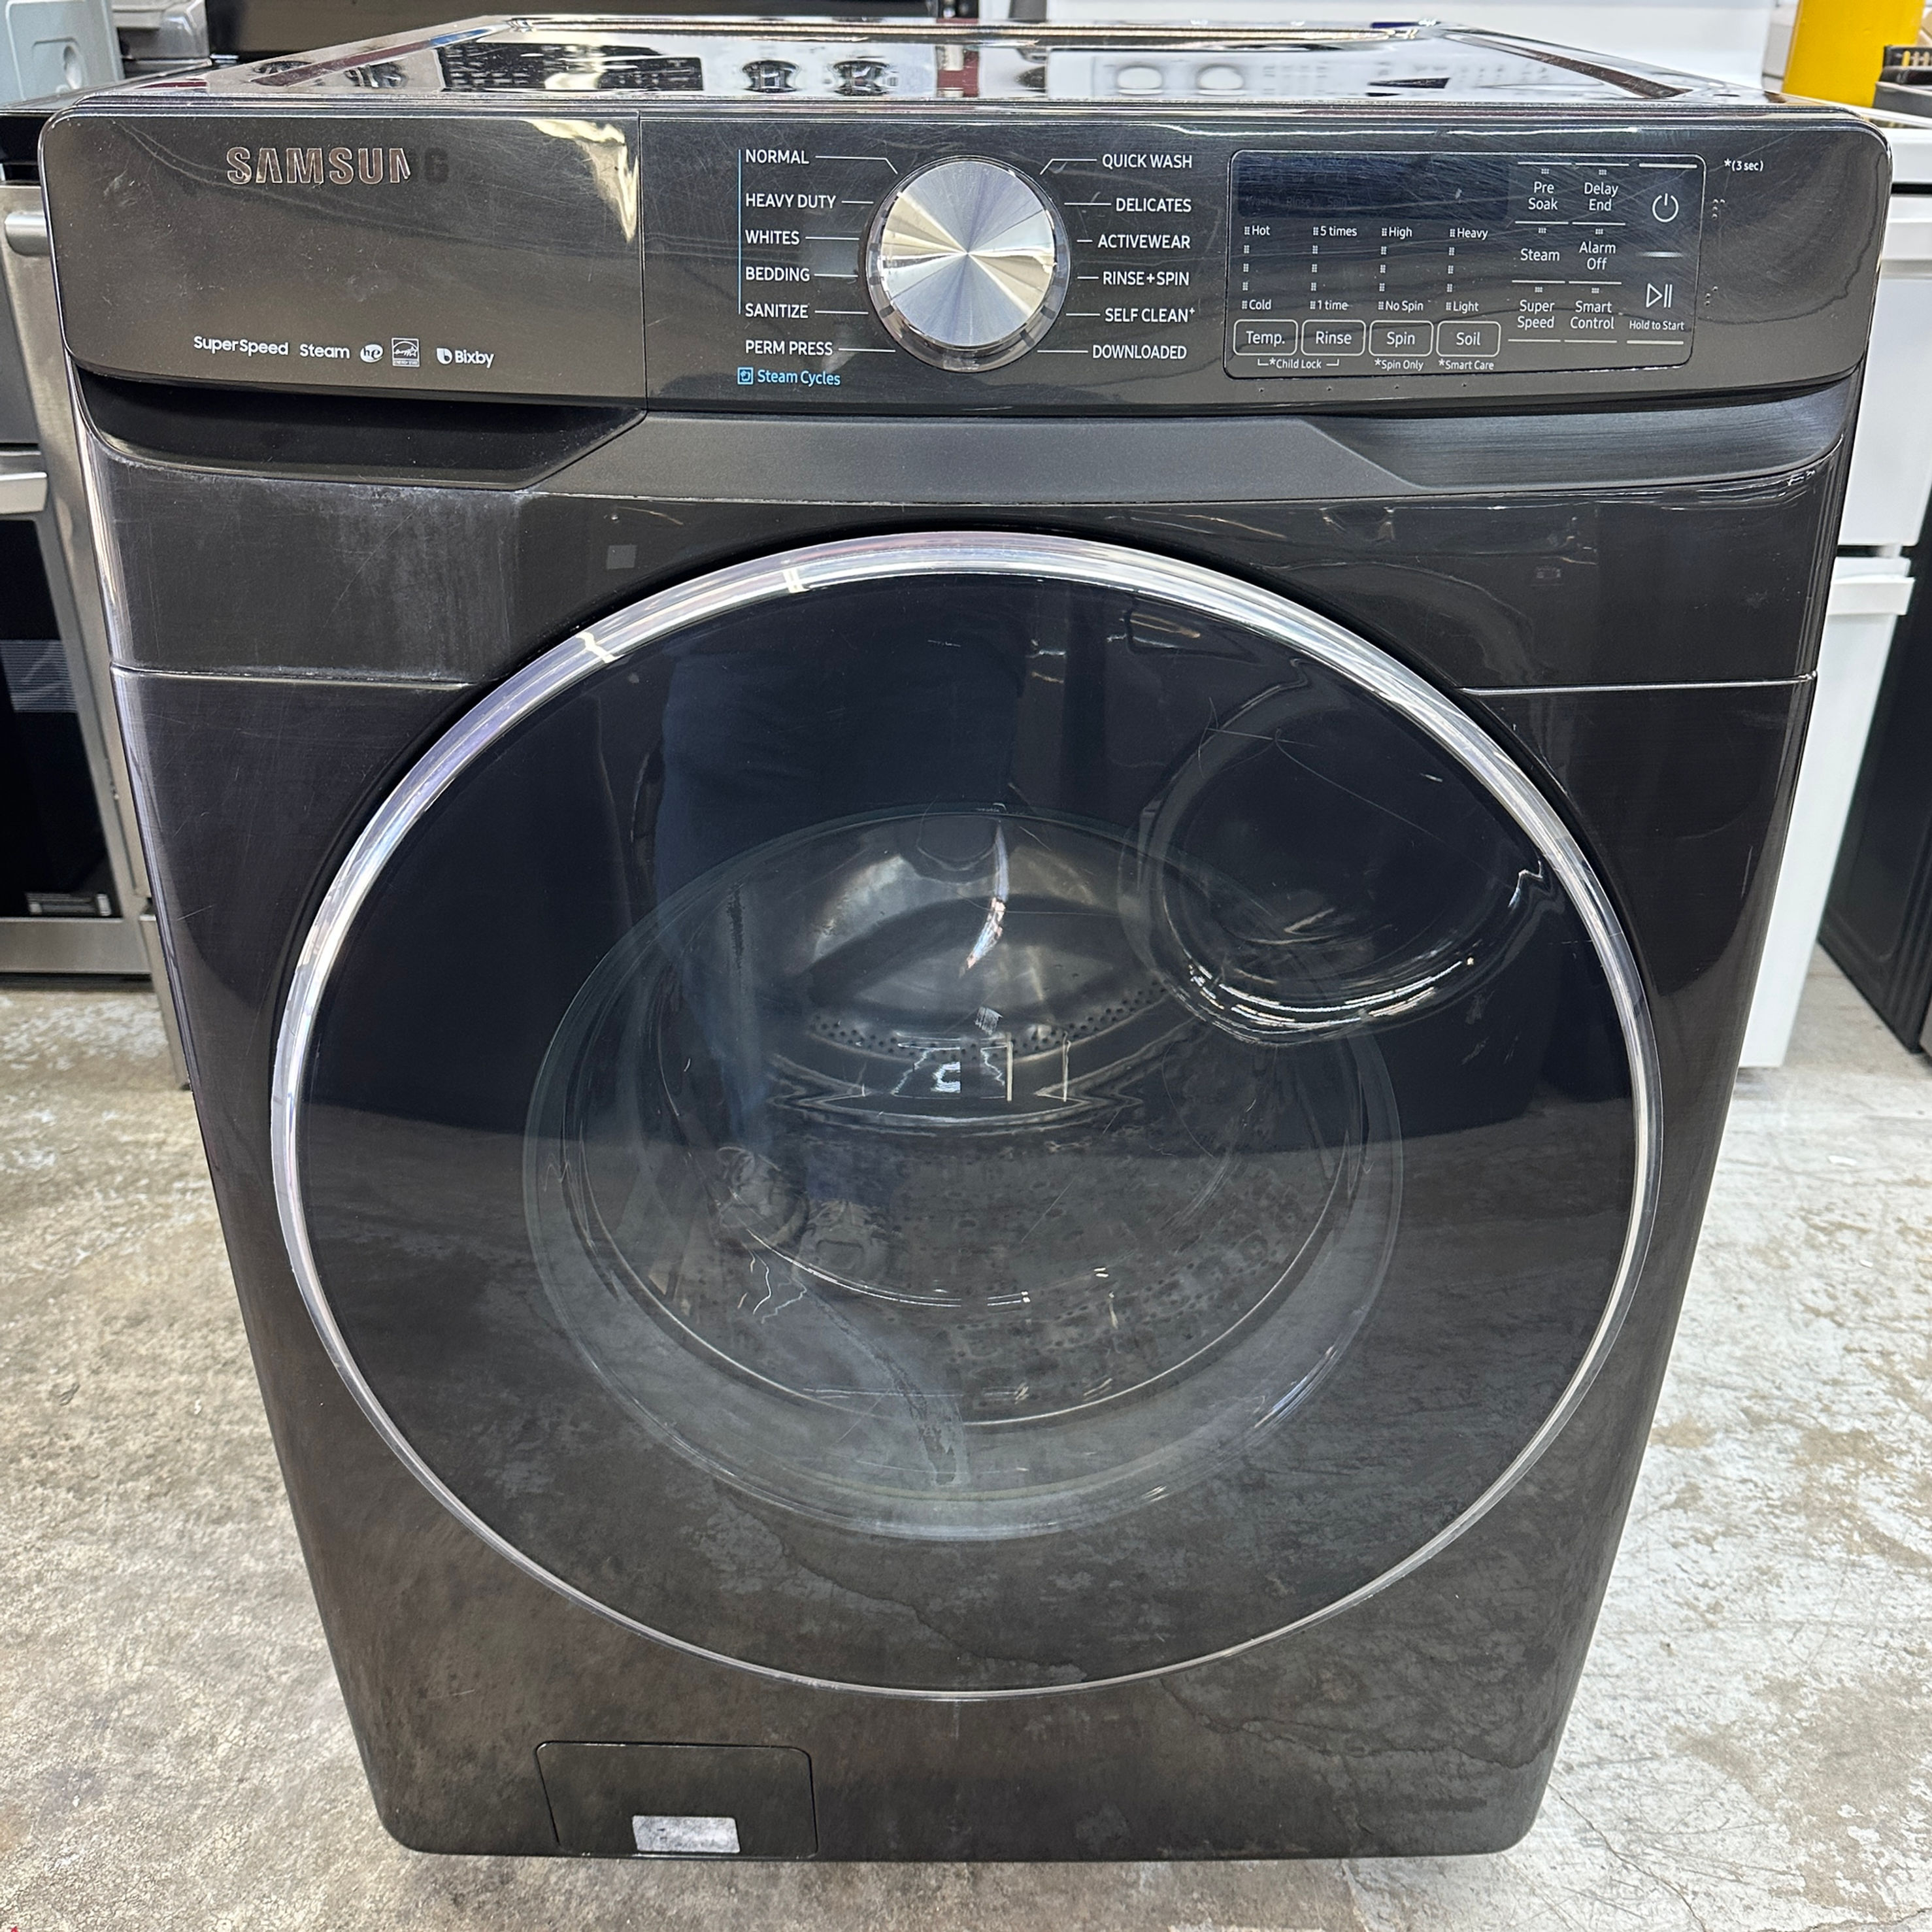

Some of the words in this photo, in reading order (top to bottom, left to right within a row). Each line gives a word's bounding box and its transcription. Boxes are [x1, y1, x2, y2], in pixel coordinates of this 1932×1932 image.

[745, 149, 810, 164] NORMAL
[1102, 154, 1147, 169] QUICK
[1150, 154, 1193, 169] WASH
[227, 147, 450, 184] SAMSUN
[1744, 160, 1764, 172] sec)
[1533, 181, 1554, 193] Pre
[1584, 182, 1619, 197] Delay
[745, 193, 795, 208] HEAVY
[797, 195, 837, 209] DUTY
[1116, 198, 1192, 212] DELICATES
[1528, 197, 1558, 210] Soak
[1589, 199, 1612, 211] End
[745, 229, 800, 245] WHITES
[1251, 225, 1271, 236] Hot
[1320, 226, 1327, 236] 5
[1329, 225, 1358, 237] times
[1388, 227, 1412, 240] High
[1457, 228, 1489, 241] Heavy
[1097, 234, 1191, 249] ACTIVEWEAR
[1579, 241, 1616, 254] Alarm
[1520, 248, 1560, 261] Steam
[1587, 258, 1608, 271] Off
[745, 267, 810, 282] BEDDING
[745, 303, 808, 318] SANITIZE
[1248, 299, 1272, 310] Cold
[1317, 300, 1322, 310] 1
[1325, 299, 1348, 310] time
[1385, 301, 1400, 311] No
[1401, 300, 1424, 312] Spin
[1453, 301, 1479, 314] Light
[1519, 299, 1555, 314] Super
[1575, 300, 1612, 313] Smart
[1105, 308, 1139, 323] SELF
[1517, 316, 1555, 331] Speed
[1570, 316, 1614, 329] Control
[1629, 320, 1650, 330] Hold
[1652, 321, 1661, 330] to
[1663, 320, 1685, 331] Start
[1246, 331, 1286, 348] Temp.
[1315, 331, 1352, 344] Rinse
[1386, 331, 1416, 348] Spin
[1456, 332, 1481, 346] Soil
[299, 344, 350, 359] Steam
[745, 340, 785, 355] PERM
[789, 341, 833, 356] PRESS
[1092, 344, 1187, 359] DOWNLOADED
[455, 350, 495, 369] Bixby
[1301, 359, 1322, 369] Lock
[1403, 359, 1424, 371] Only
[1474, 360, 1495, 371] Care
[757, 369, 797, 384] Steam
[800, 370, 841, 387] Cycles
